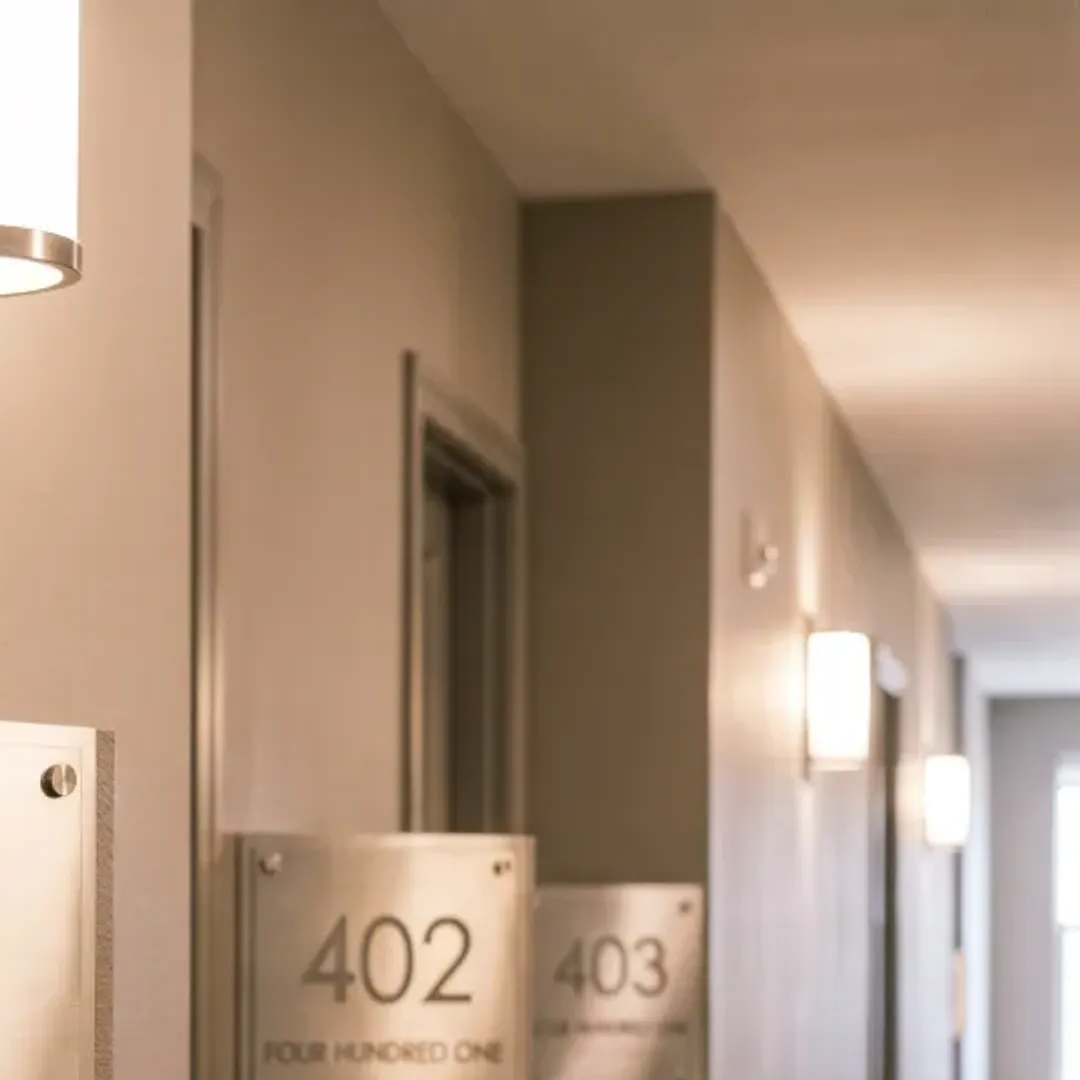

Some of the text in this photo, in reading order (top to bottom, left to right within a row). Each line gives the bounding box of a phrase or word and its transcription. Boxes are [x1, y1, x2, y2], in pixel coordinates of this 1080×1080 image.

[301, 914, 473, 1005] 402
[553, 933, 669, 1000] 403
[264, 1040, 504, 1064] FOUR HUNDRED ONE
